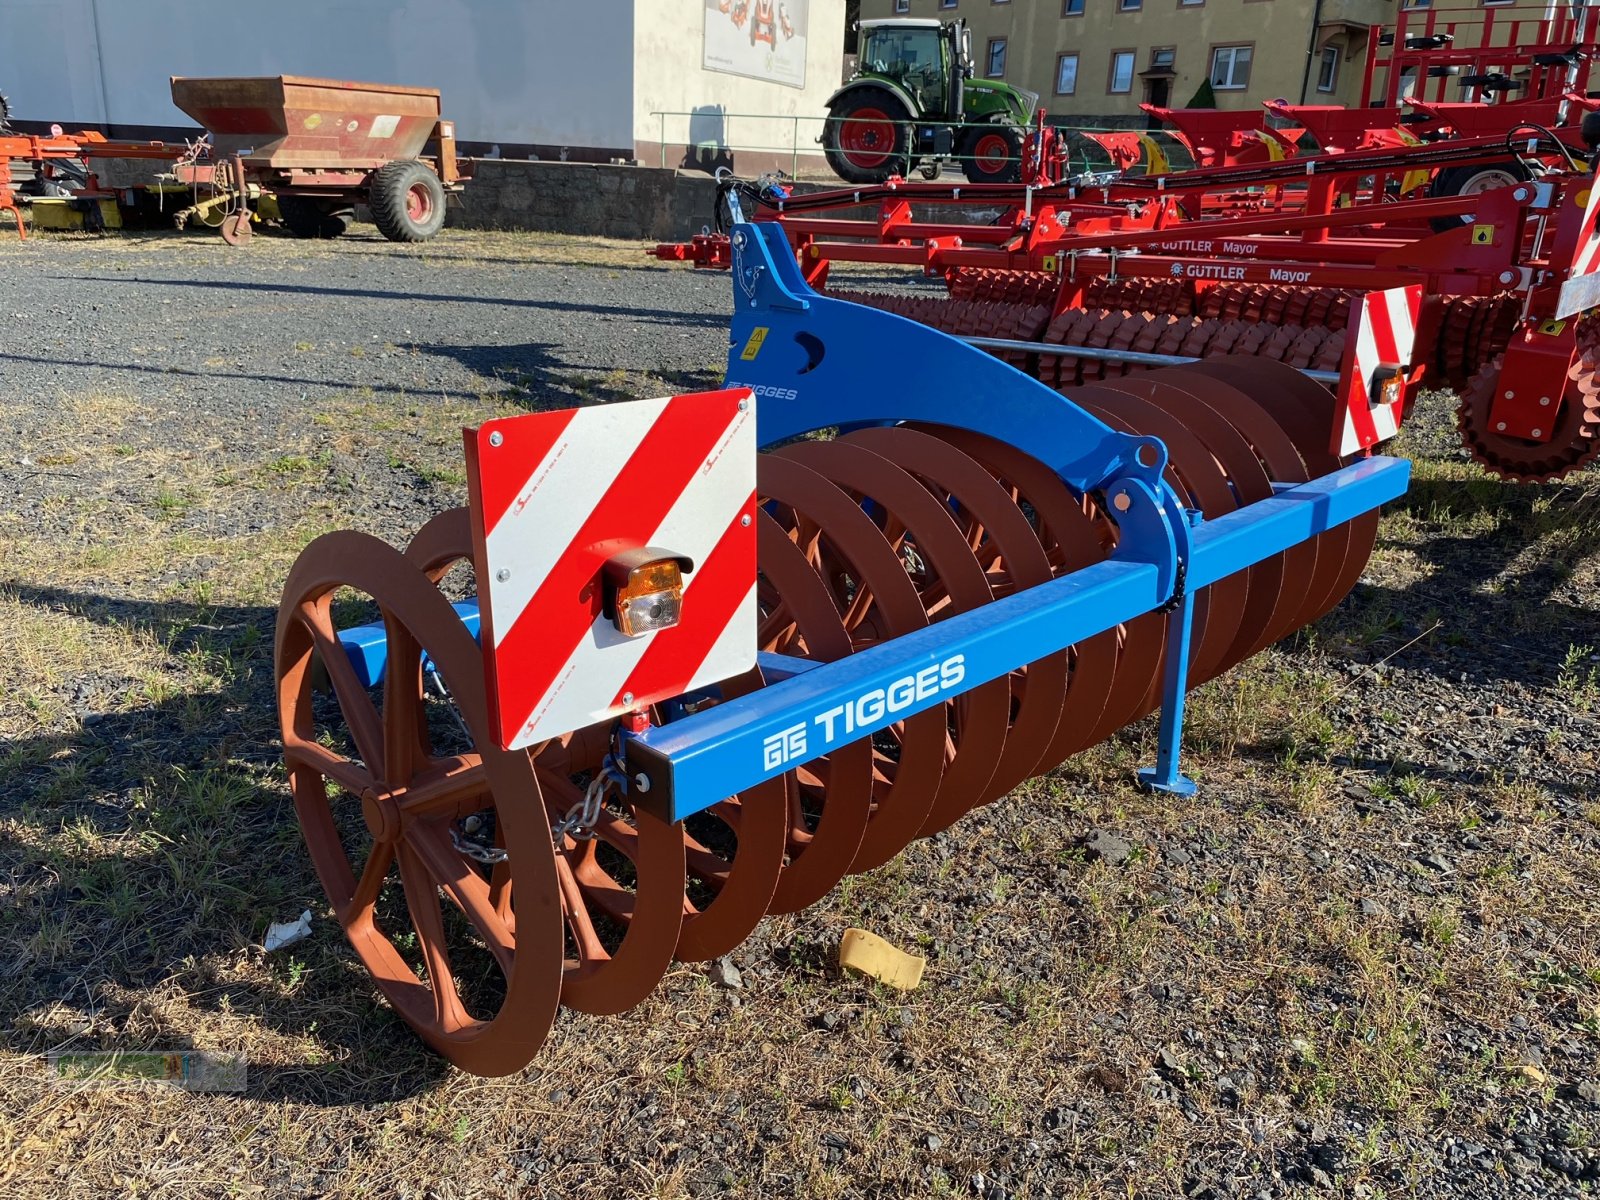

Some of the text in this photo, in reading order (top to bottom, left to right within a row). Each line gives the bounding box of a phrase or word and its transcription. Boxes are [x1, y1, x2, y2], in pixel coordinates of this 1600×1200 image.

[1223, 241, 1258, 255] Mayor
[1186, 264, 1311, 283] GÜTTLER Mayor
[763, 653, 966, 772] GTS TIGGES
